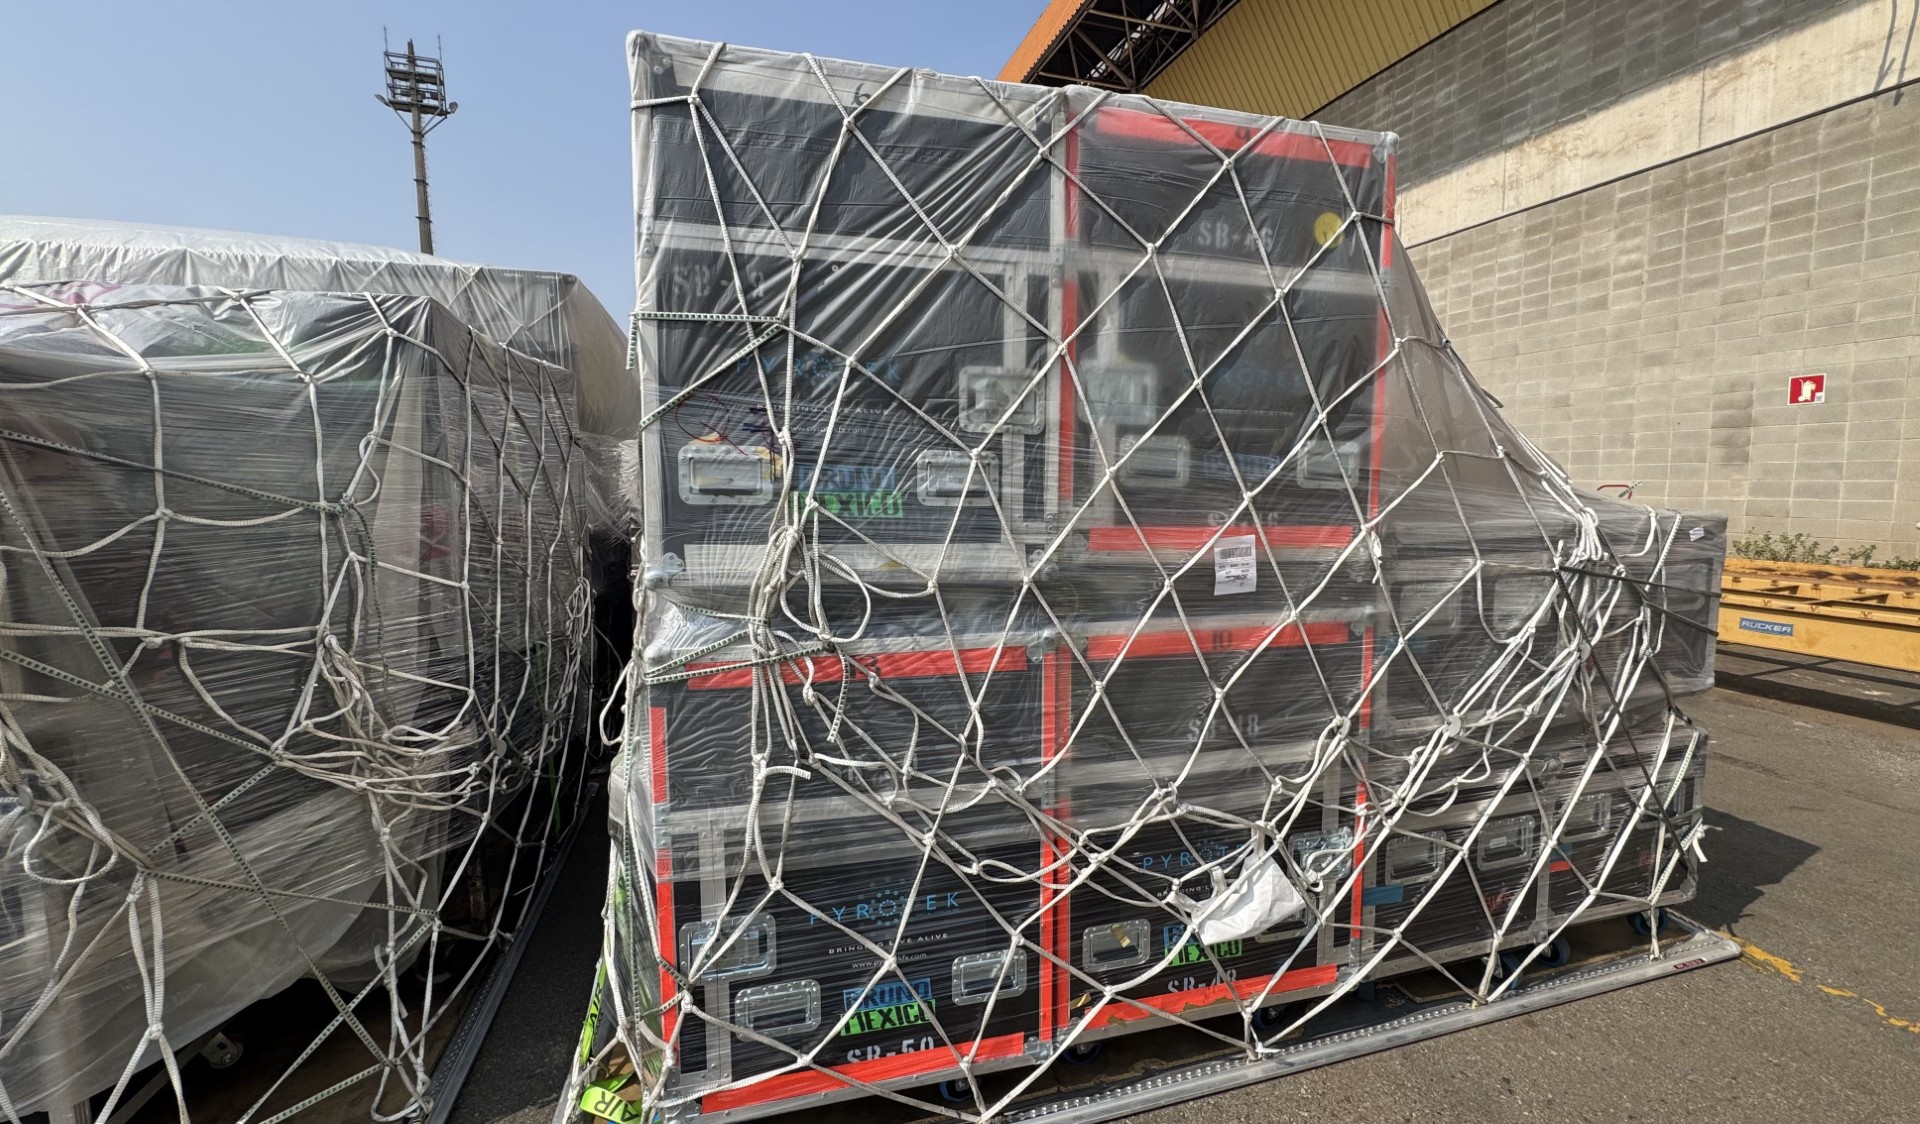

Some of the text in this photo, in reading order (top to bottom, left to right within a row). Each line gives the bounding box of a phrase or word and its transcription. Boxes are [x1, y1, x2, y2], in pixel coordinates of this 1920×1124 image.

[1741, 620, 1792, 633] RUCKER
[810, 892, 959, 926] PYROEK
[917, 933, 949, 942] ALIVE
[844, 1000, 934, 1034] MEXICO
[594, 1090, 640, 1122] AIR
